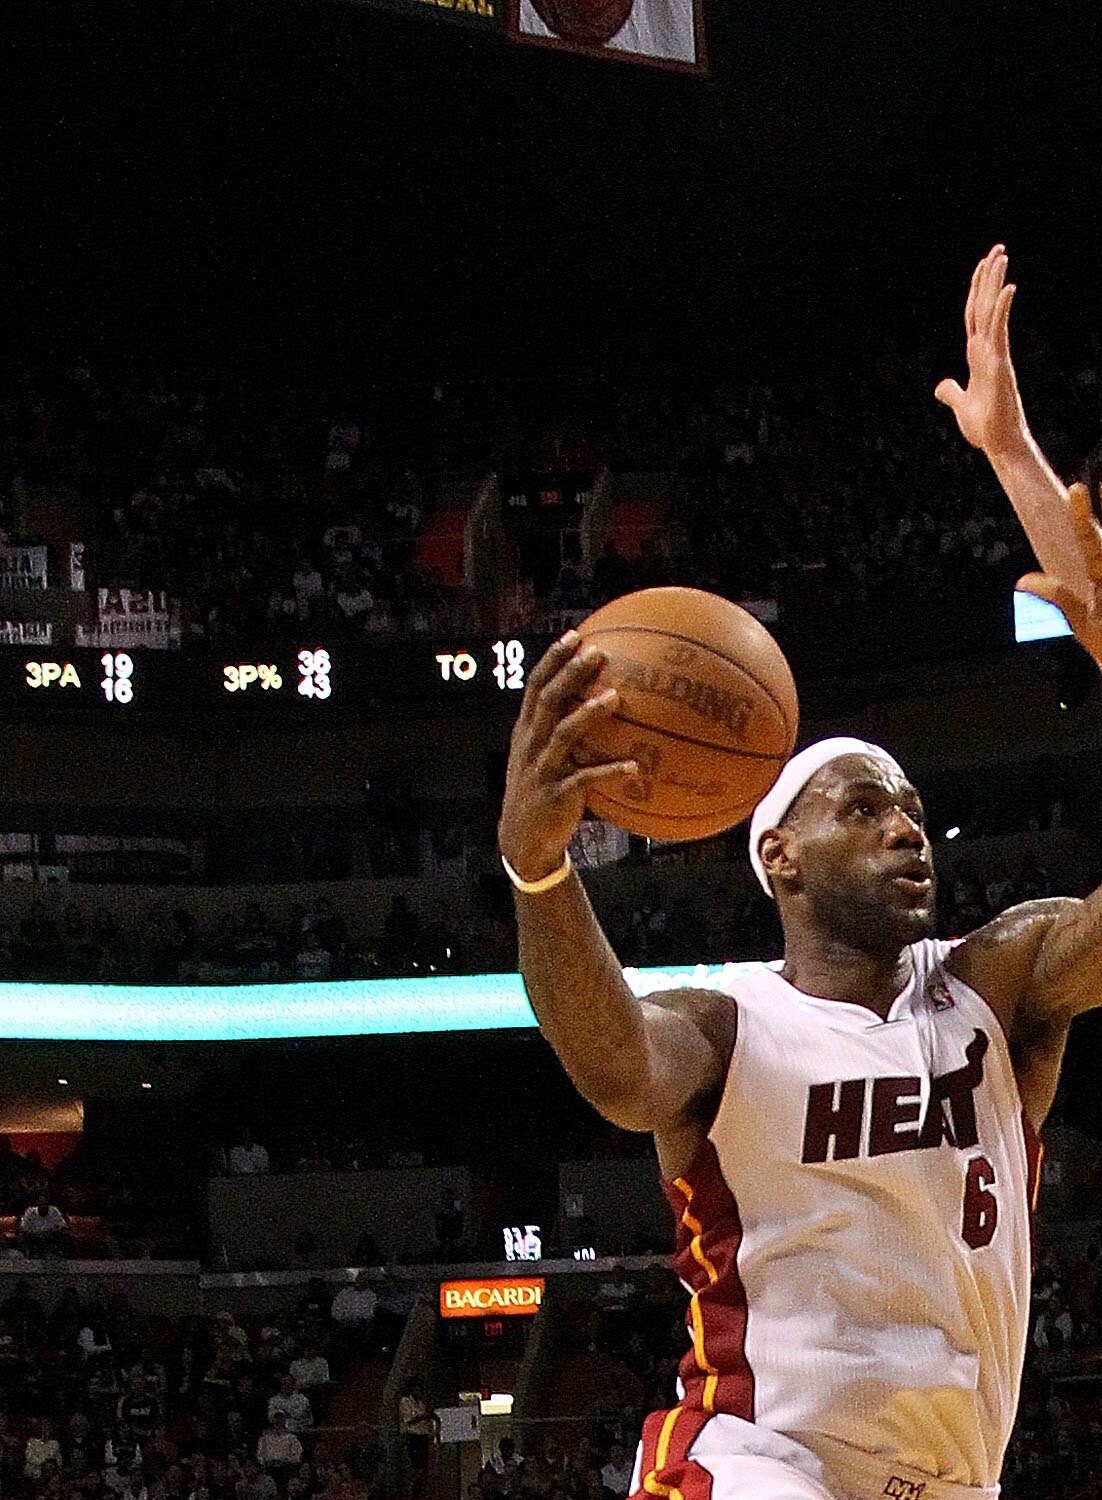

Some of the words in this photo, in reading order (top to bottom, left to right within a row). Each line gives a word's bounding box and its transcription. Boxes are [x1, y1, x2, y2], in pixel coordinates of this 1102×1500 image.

[101, 652, 134, 679] 19
[298, 649, 332, 676] 36
[493, 640, 525, 665] 10
[25, 660, 82, 689] 3PA
[223, 664, 282, 692] 3P%
[436, 653, 477, 681] TO
[493, 663, 525, 690] 12
[101, 676, 134, 704] 16
[298, 673, 332, 700] 43
[801, 1028, 990, 1165] HEAT
[961, 1156, 999, 1251] 6
[445, 1286, 542, 1309] BACARDI
